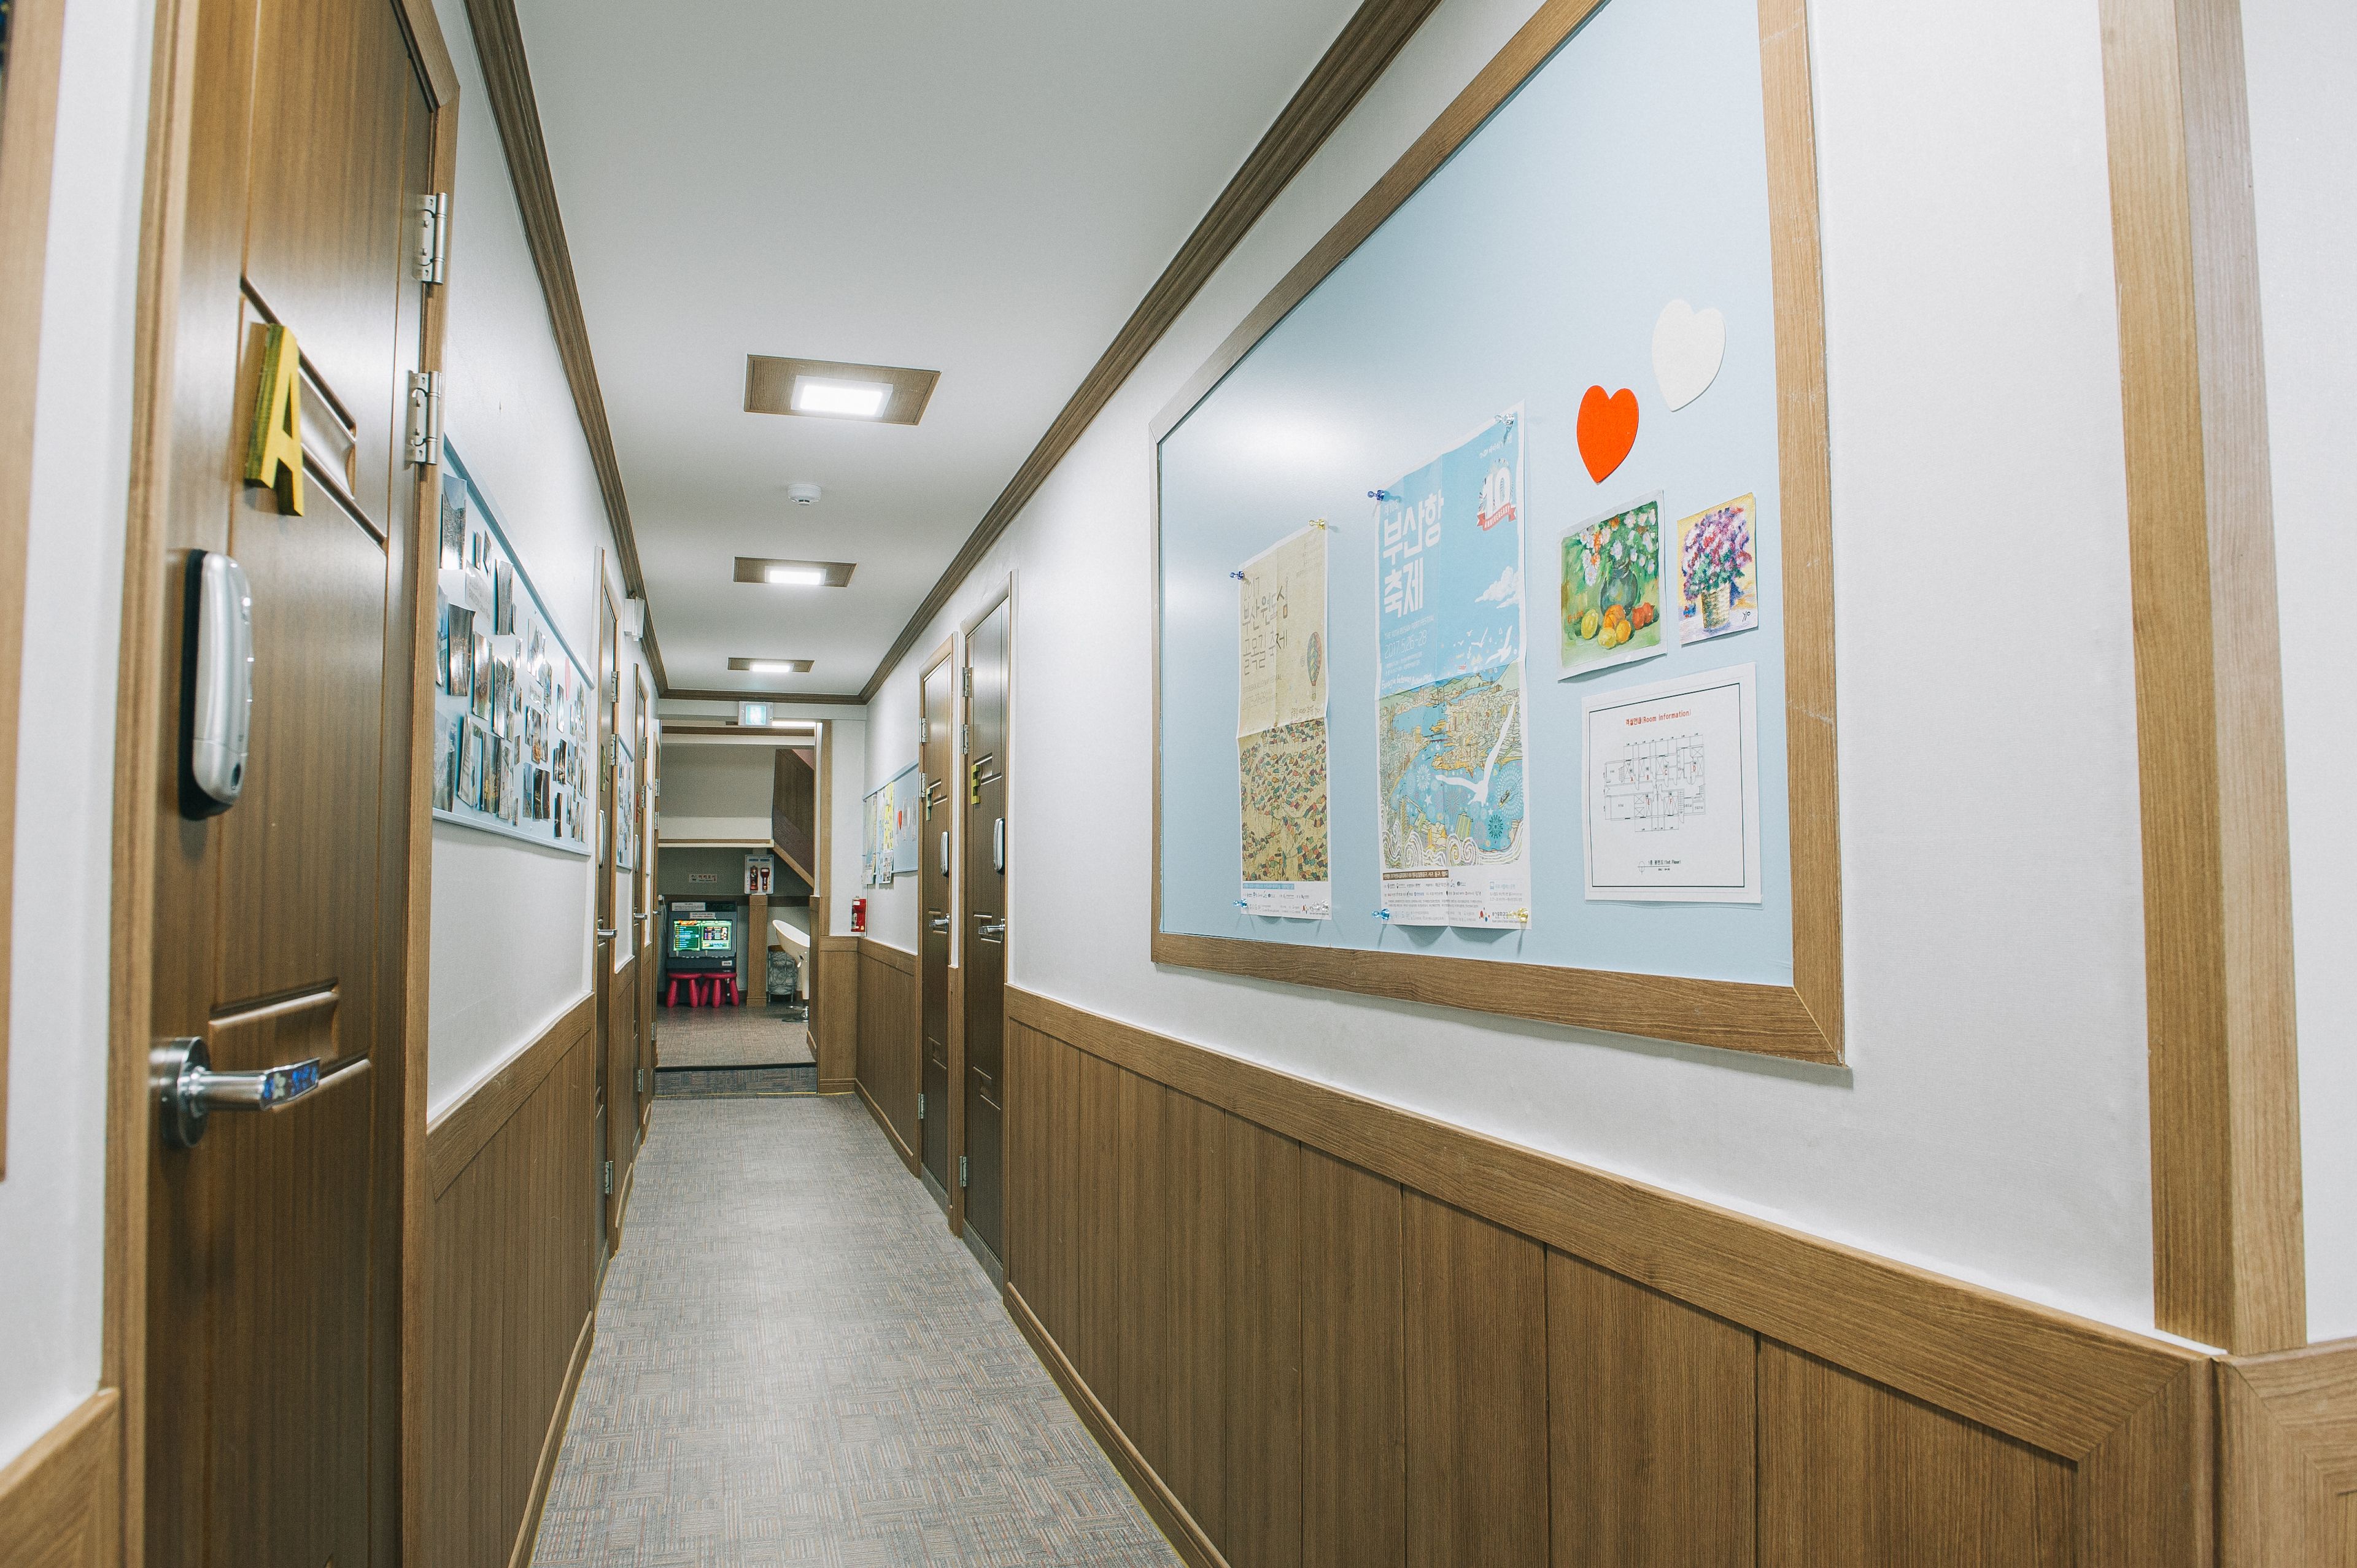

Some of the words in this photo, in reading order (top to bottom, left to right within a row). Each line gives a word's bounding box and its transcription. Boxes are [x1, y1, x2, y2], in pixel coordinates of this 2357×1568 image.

[248, 324, 303, 516] A
[1482, 466, 1511, 519] 10
[1484, 504, 1511, 528] ANNIVERSARY
[1383, 489, 1444, 565] 부산항
[1243, 576, 1260, 602] 2017
[1384, 557, 1423, 618] 축제
